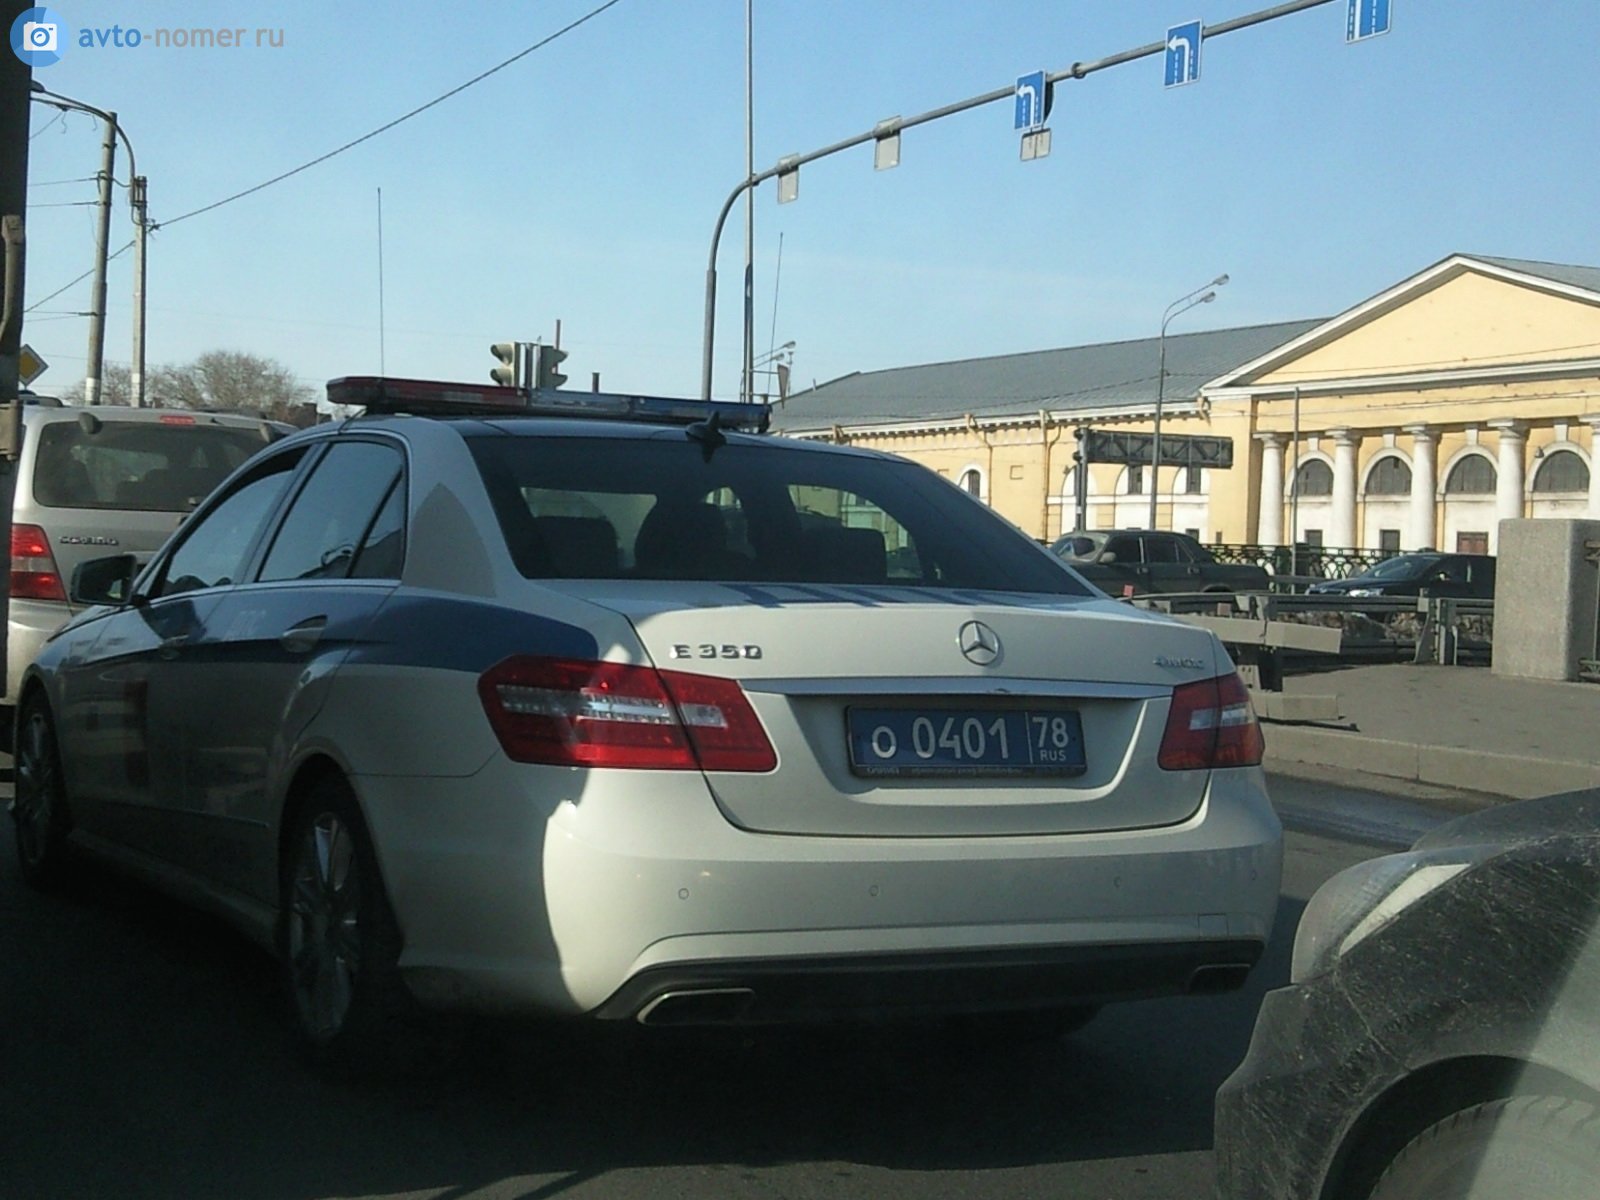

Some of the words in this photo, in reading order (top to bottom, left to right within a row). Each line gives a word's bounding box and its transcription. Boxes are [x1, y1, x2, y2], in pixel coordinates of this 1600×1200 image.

[670, 644, 692, 659] E
[698, 644, 763, 660] 350
[912, 716, 1009, 760] 0401
[1031, 716, 1069, 749] 78
[1039, 749, 1067, 762] RUS
